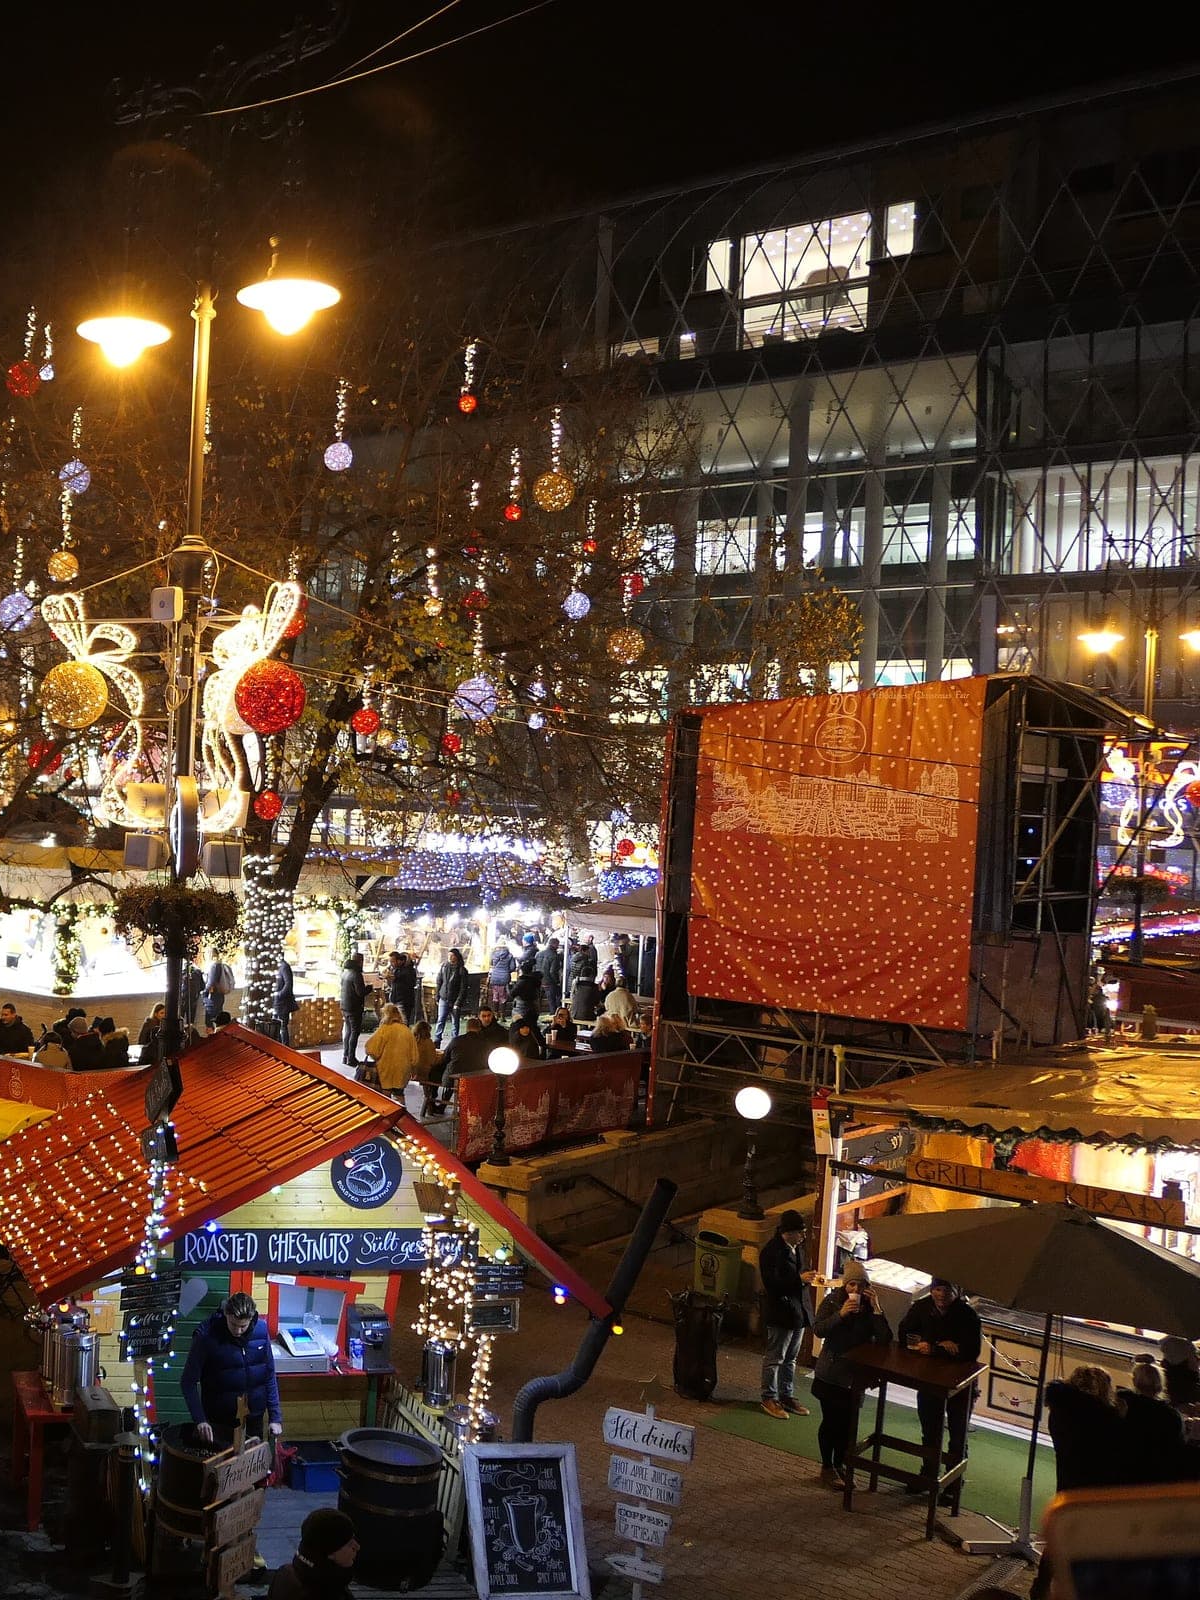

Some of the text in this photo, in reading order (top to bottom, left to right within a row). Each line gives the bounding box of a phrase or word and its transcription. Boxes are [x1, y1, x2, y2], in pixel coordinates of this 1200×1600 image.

[915, 1159, 994, 1191] GRILL
[336, 1179, 393, 1203] ROASTED CHESTNUTS
[179, 1232, 258, 1265] ROASTED
[268, 1232, 353, 1265] CHESTNUTS
[359, 1231, 400, 1256] Sült
[608, 1416, 688, 1455] Hot drinks
[614, 1460, 668, 1487] HOT APPLE JUICE
[621, 1478, 675, 1504] HOT SPICY PLUM
[618, 1507, 664, 1528] COFFEE
[631, 1524, 661, 1545] TEA
